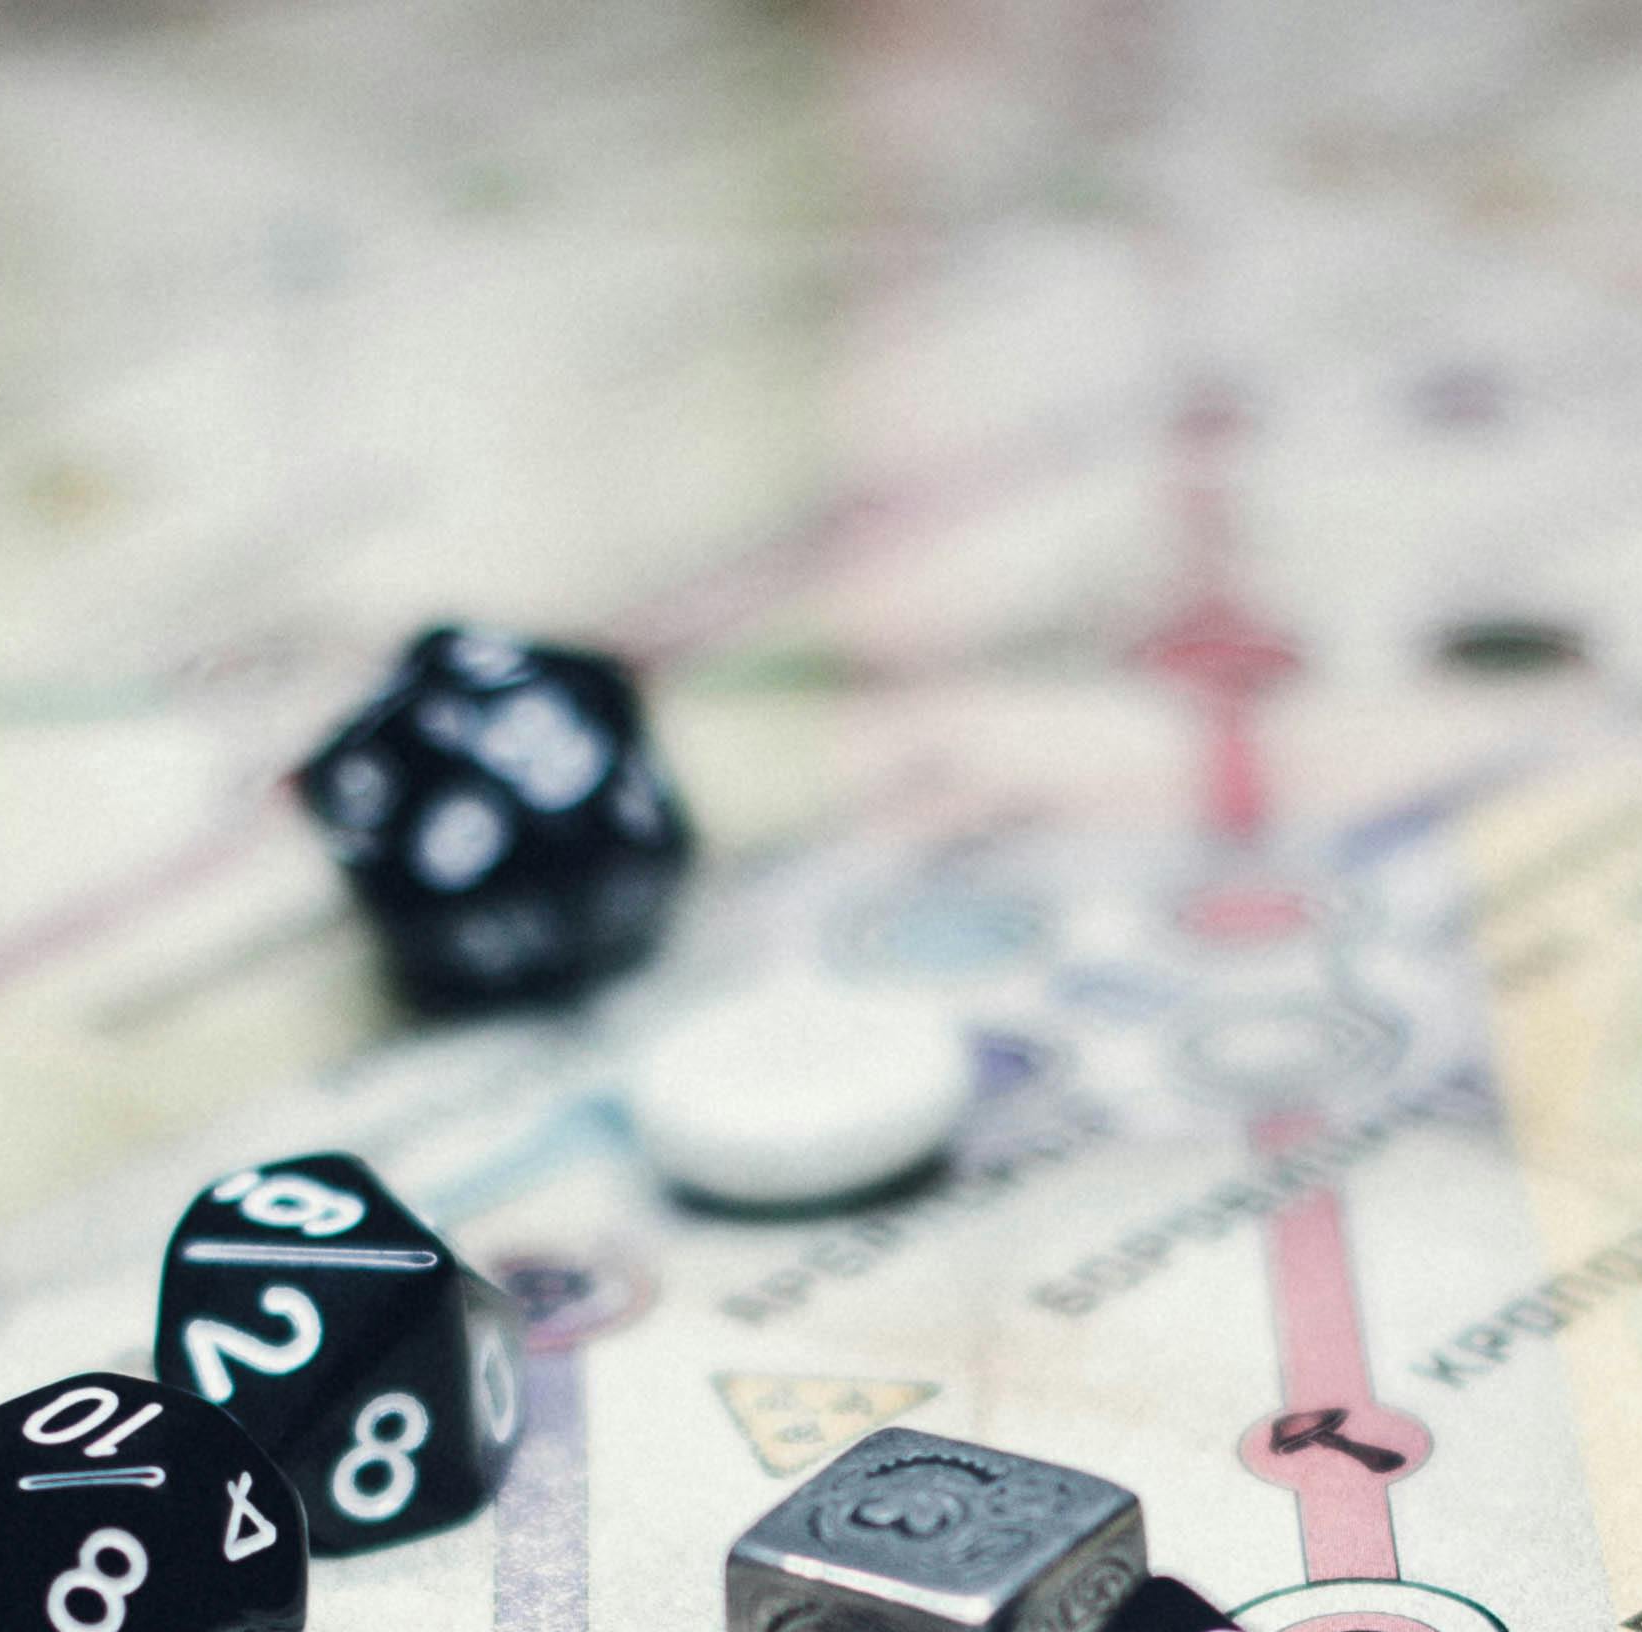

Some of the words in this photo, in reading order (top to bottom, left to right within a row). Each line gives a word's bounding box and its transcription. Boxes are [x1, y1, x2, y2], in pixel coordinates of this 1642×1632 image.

[182, 1285, 324, 1404] 2
[22, 1385, 163, 1458] 10
[330, 1391, 430, 1523] 8
[222, 1469, 278, 1564] 4
